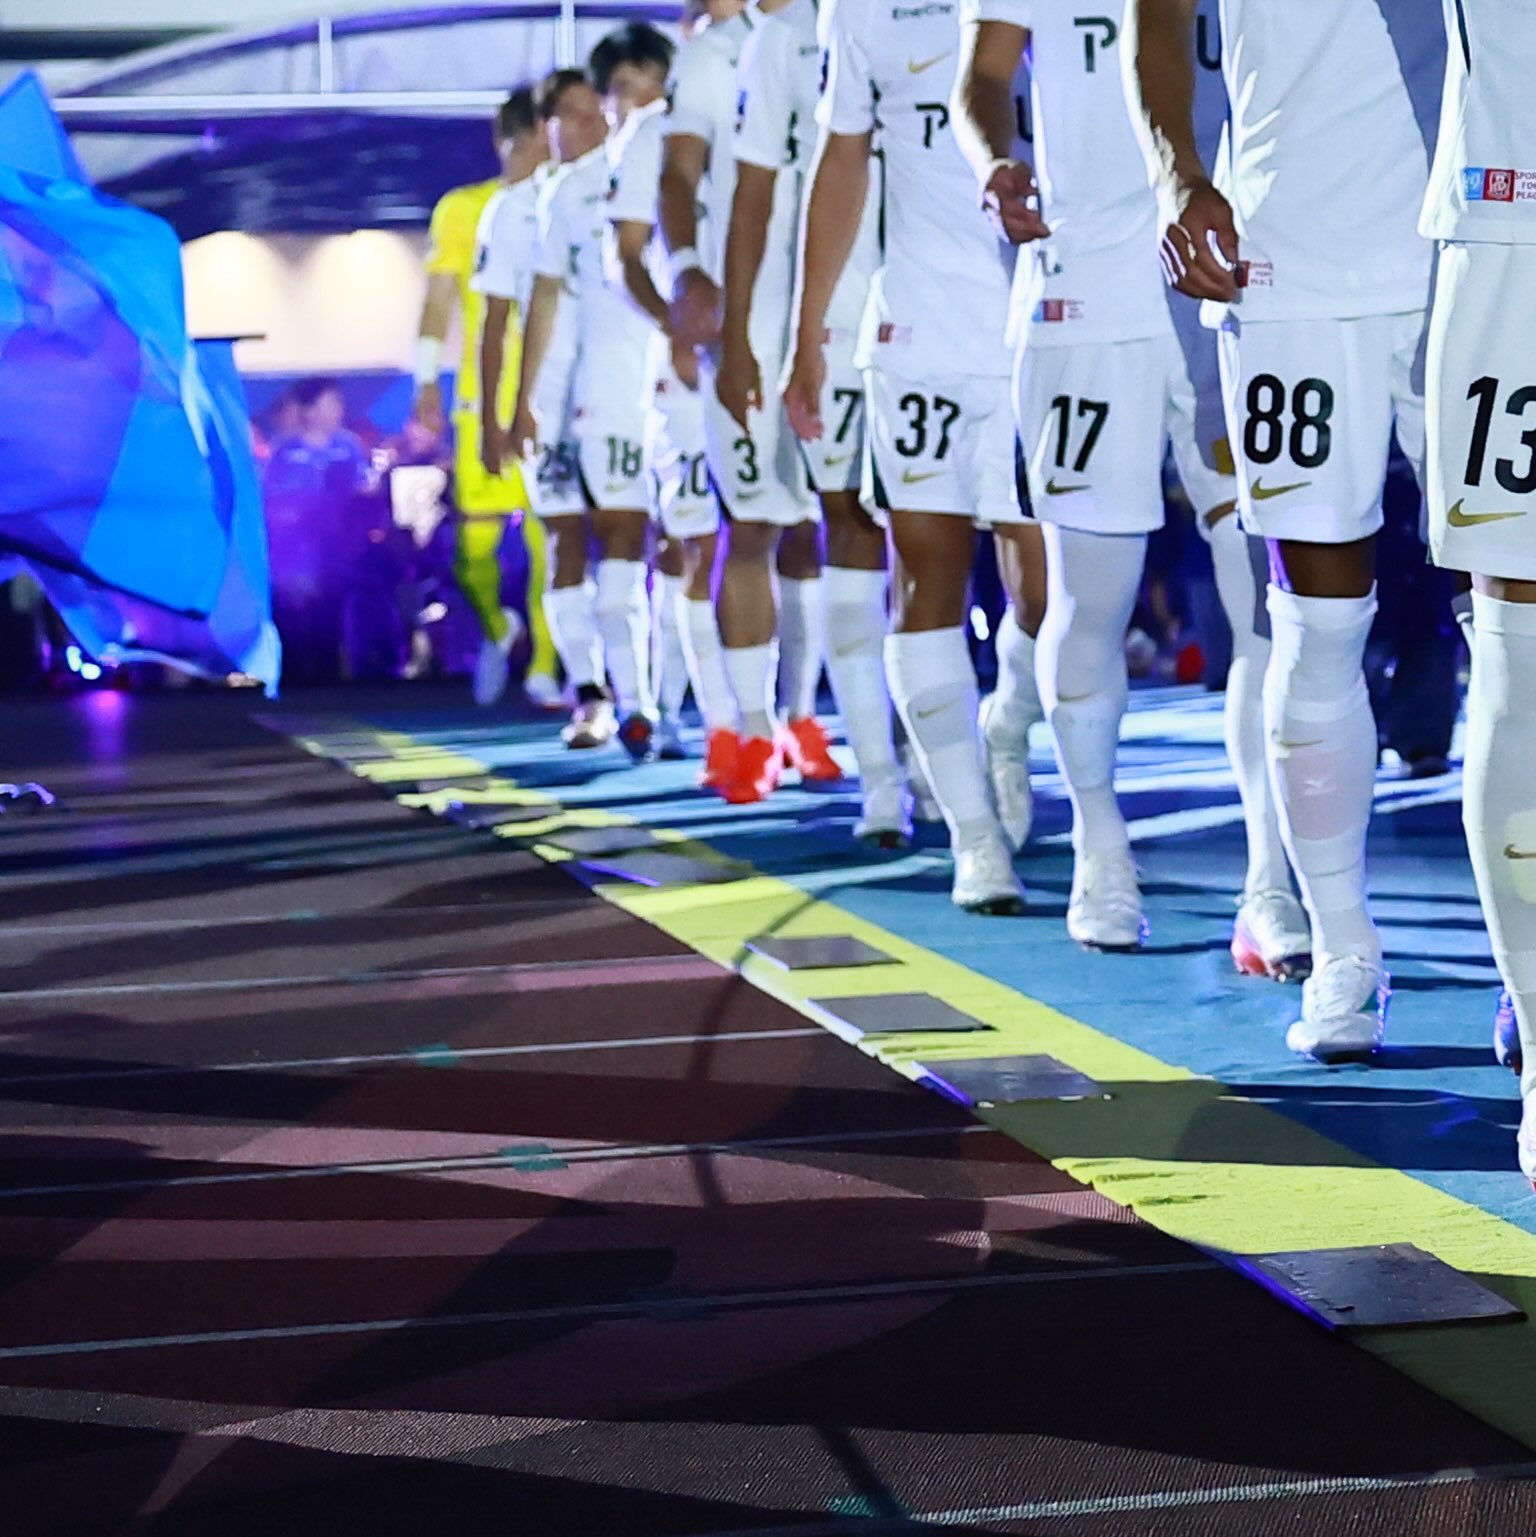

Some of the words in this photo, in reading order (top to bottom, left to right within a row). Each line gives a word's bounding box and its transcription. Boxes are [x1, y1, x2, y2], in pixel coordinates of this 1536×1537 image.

[895, 393, 961, 460] 37
[1050, 395, 1109, 473] 17
[1243, 373, 1335, 469] 88
[733, 437, 759, 483] 3
